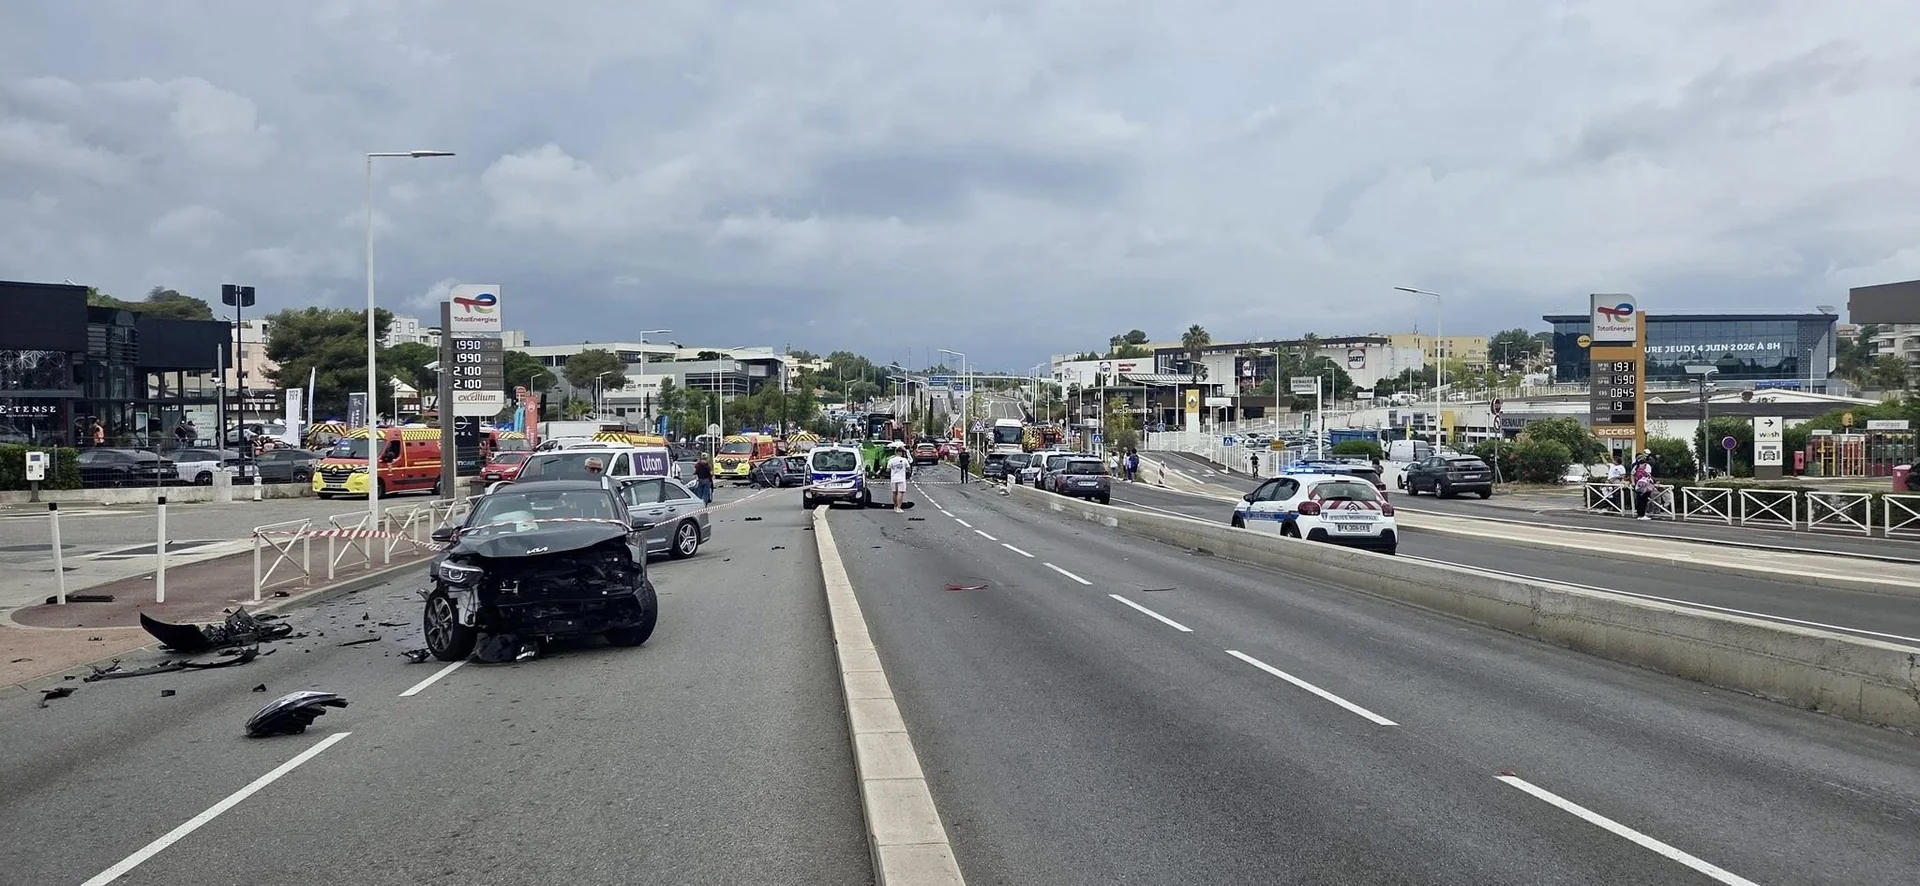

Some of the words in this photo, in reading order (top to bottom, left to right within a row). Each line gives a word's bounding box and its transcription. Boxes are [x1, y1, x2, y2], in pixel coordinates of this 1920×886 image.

[453, 316, 498, 324] TotalEnergies
[1697, 344, 1704, 352] 4
[1705, 343, 1728, 352] JUIN
[1730, 342, 1756, 351] 2026
[1766, 341, 1781, 350] 8H
[1349, 355, 1365, 363] DARTY
[457, 392, 496, 402] excellium
[1502, 418, 1526, 428] RENAULT
[1598, 428, 1636, 436] access
